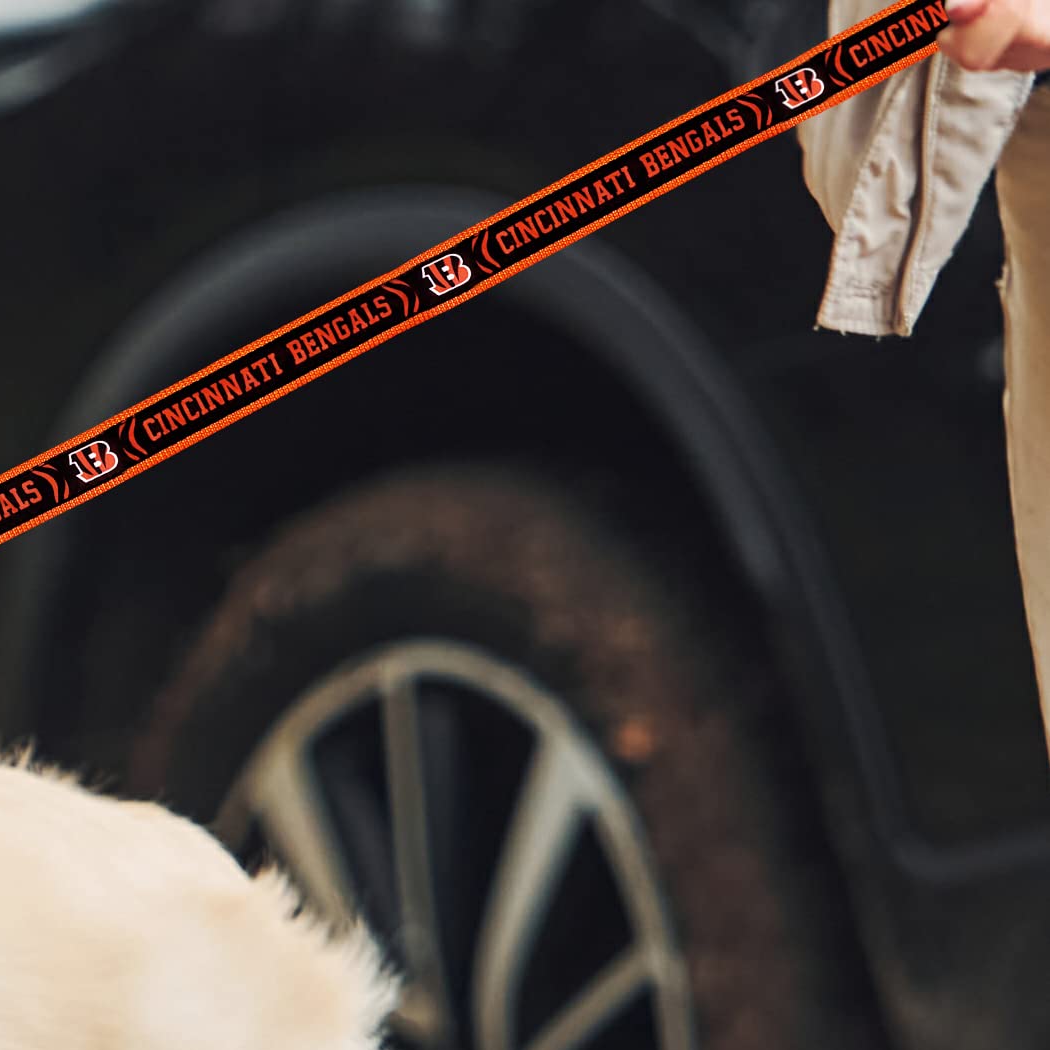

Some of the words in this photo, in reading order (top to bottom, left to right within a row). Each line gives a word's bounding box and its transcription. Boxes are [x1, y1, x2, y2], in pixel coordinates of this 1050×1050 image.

[775, 67, 825, 109] B
[495, 166, 636, 255] CINCINNATI
[639, 108, 746, 178] BENGALS
[422, 253, 471, 296] B
[143, 352, 283, 443] CINCINNATI
[286, 295, 393, 366] BENGALS
[68, 440, 119, 483] B
